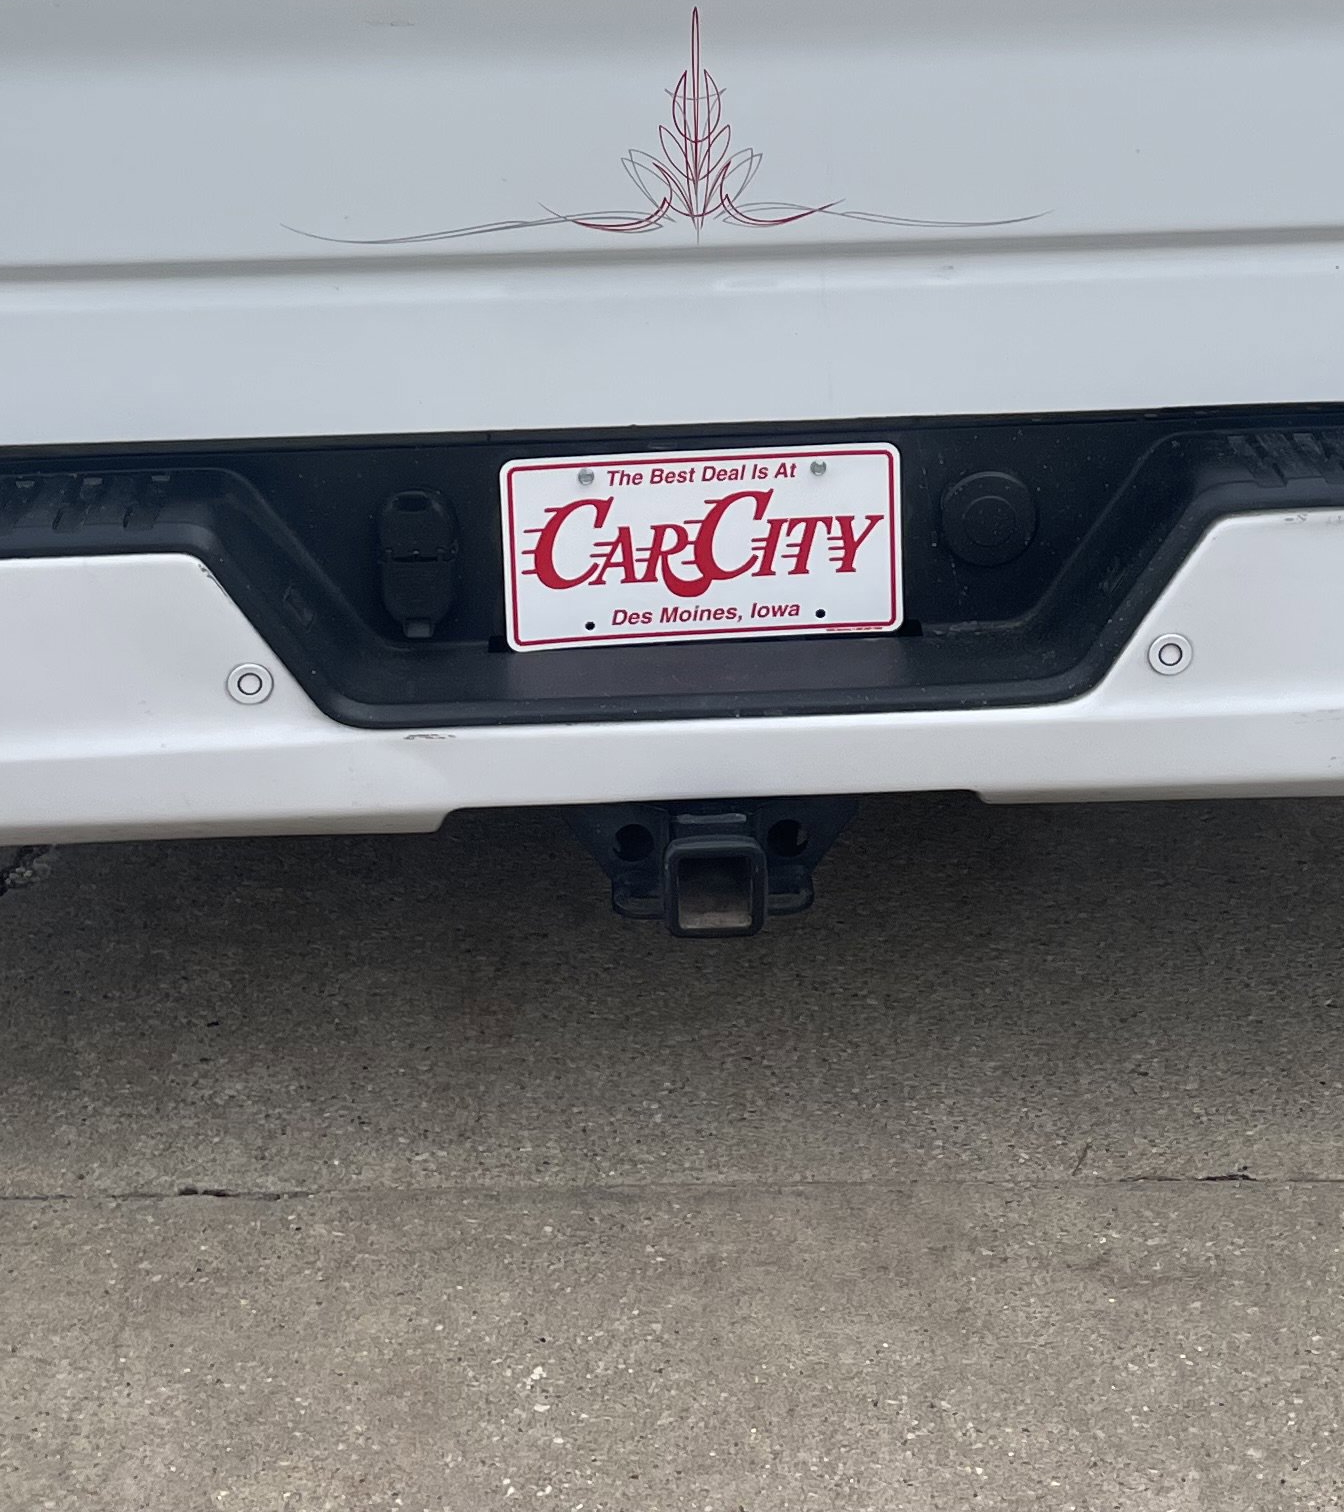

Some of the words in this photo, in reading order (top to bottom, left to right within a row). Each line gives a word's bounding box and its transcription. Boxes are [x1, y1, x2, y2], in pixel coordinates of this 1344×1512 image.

[607, 469, 645, 487] The
[650, 466, 695, 485] Best
[701, 464, 745, 483] Deal
[751, 463, 769, 481] Is
[774, 462, 798, 480] At
[611, 608, 653, 627] Des
[659, 604, 743, 624] Moines,
[751, 602, 800, 619] Iowa
